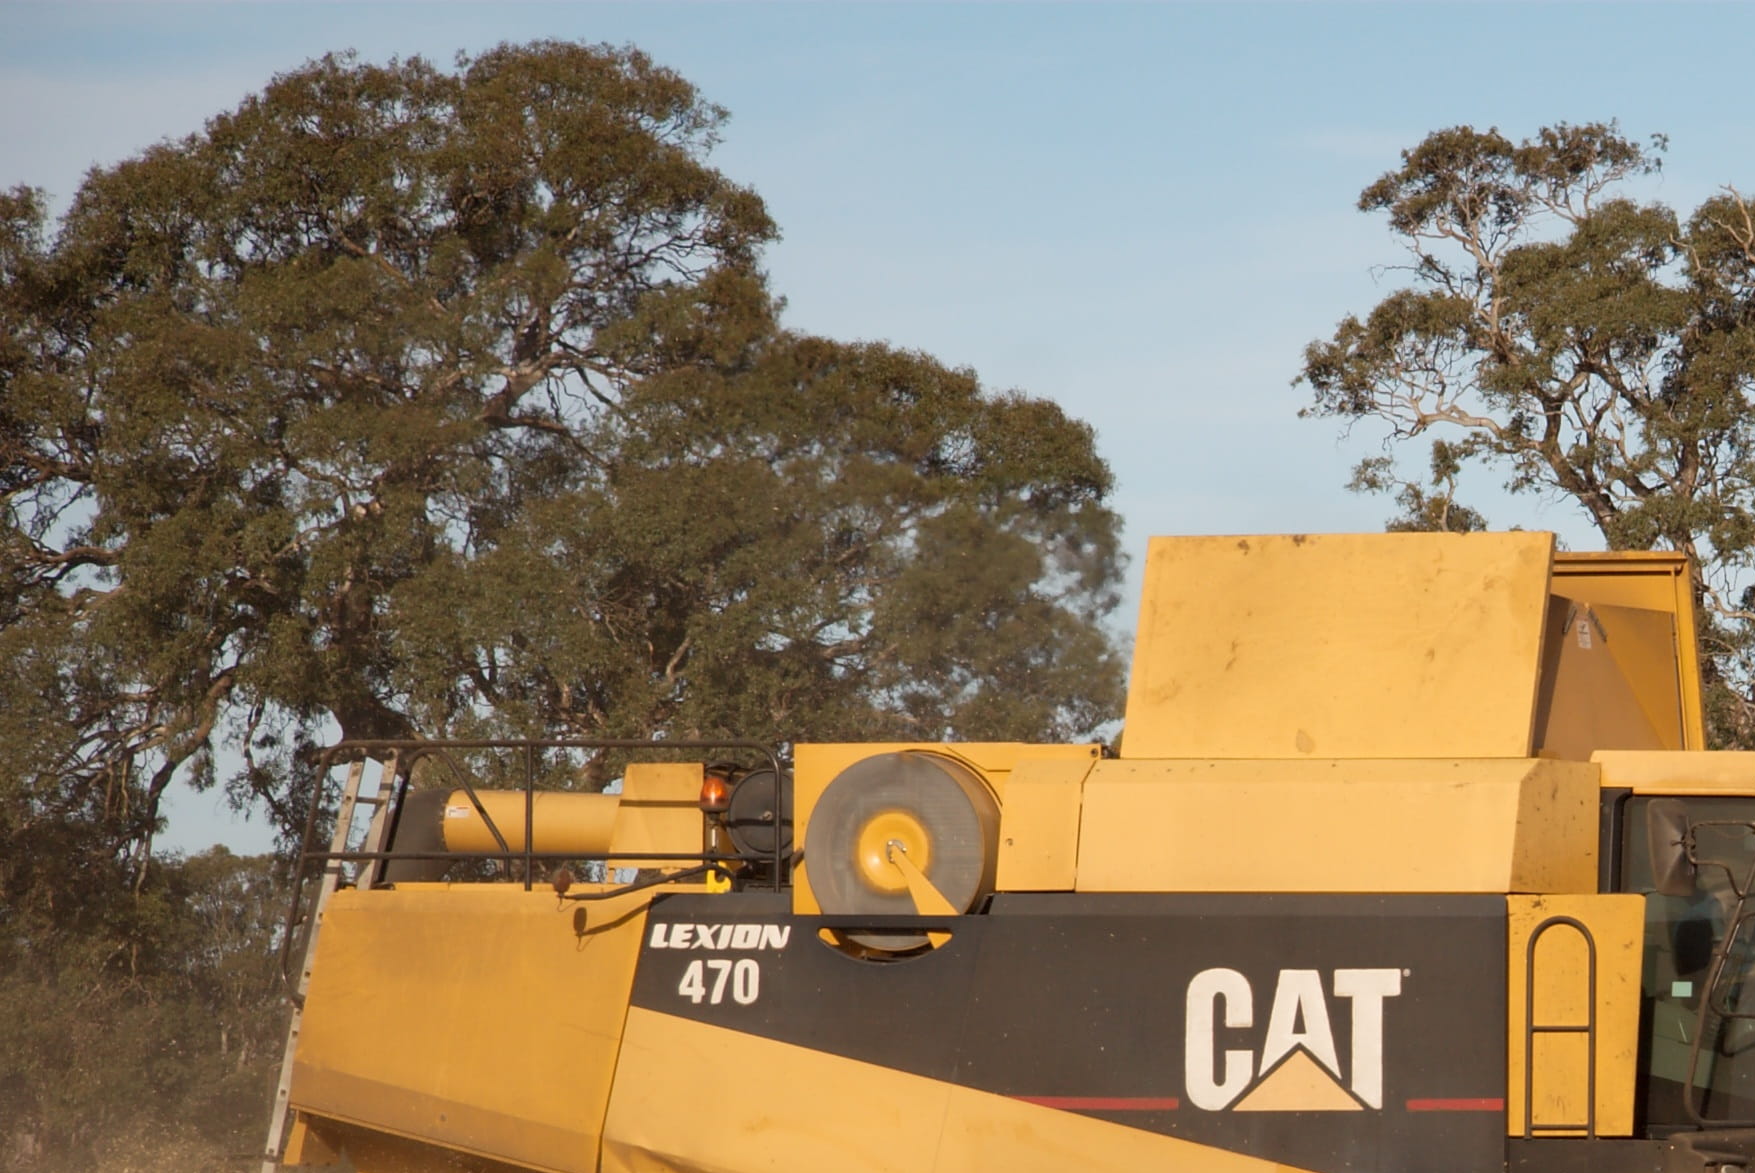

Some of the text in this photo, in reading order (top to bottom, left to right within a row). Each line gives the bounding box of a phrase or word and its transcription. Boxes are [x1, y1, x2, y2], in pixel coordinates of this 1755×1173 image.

[649, 923, 791, 950] LEXION
[678, 958, 760, 1005] 470
[1185, 967, 1401, 1111] CAT
